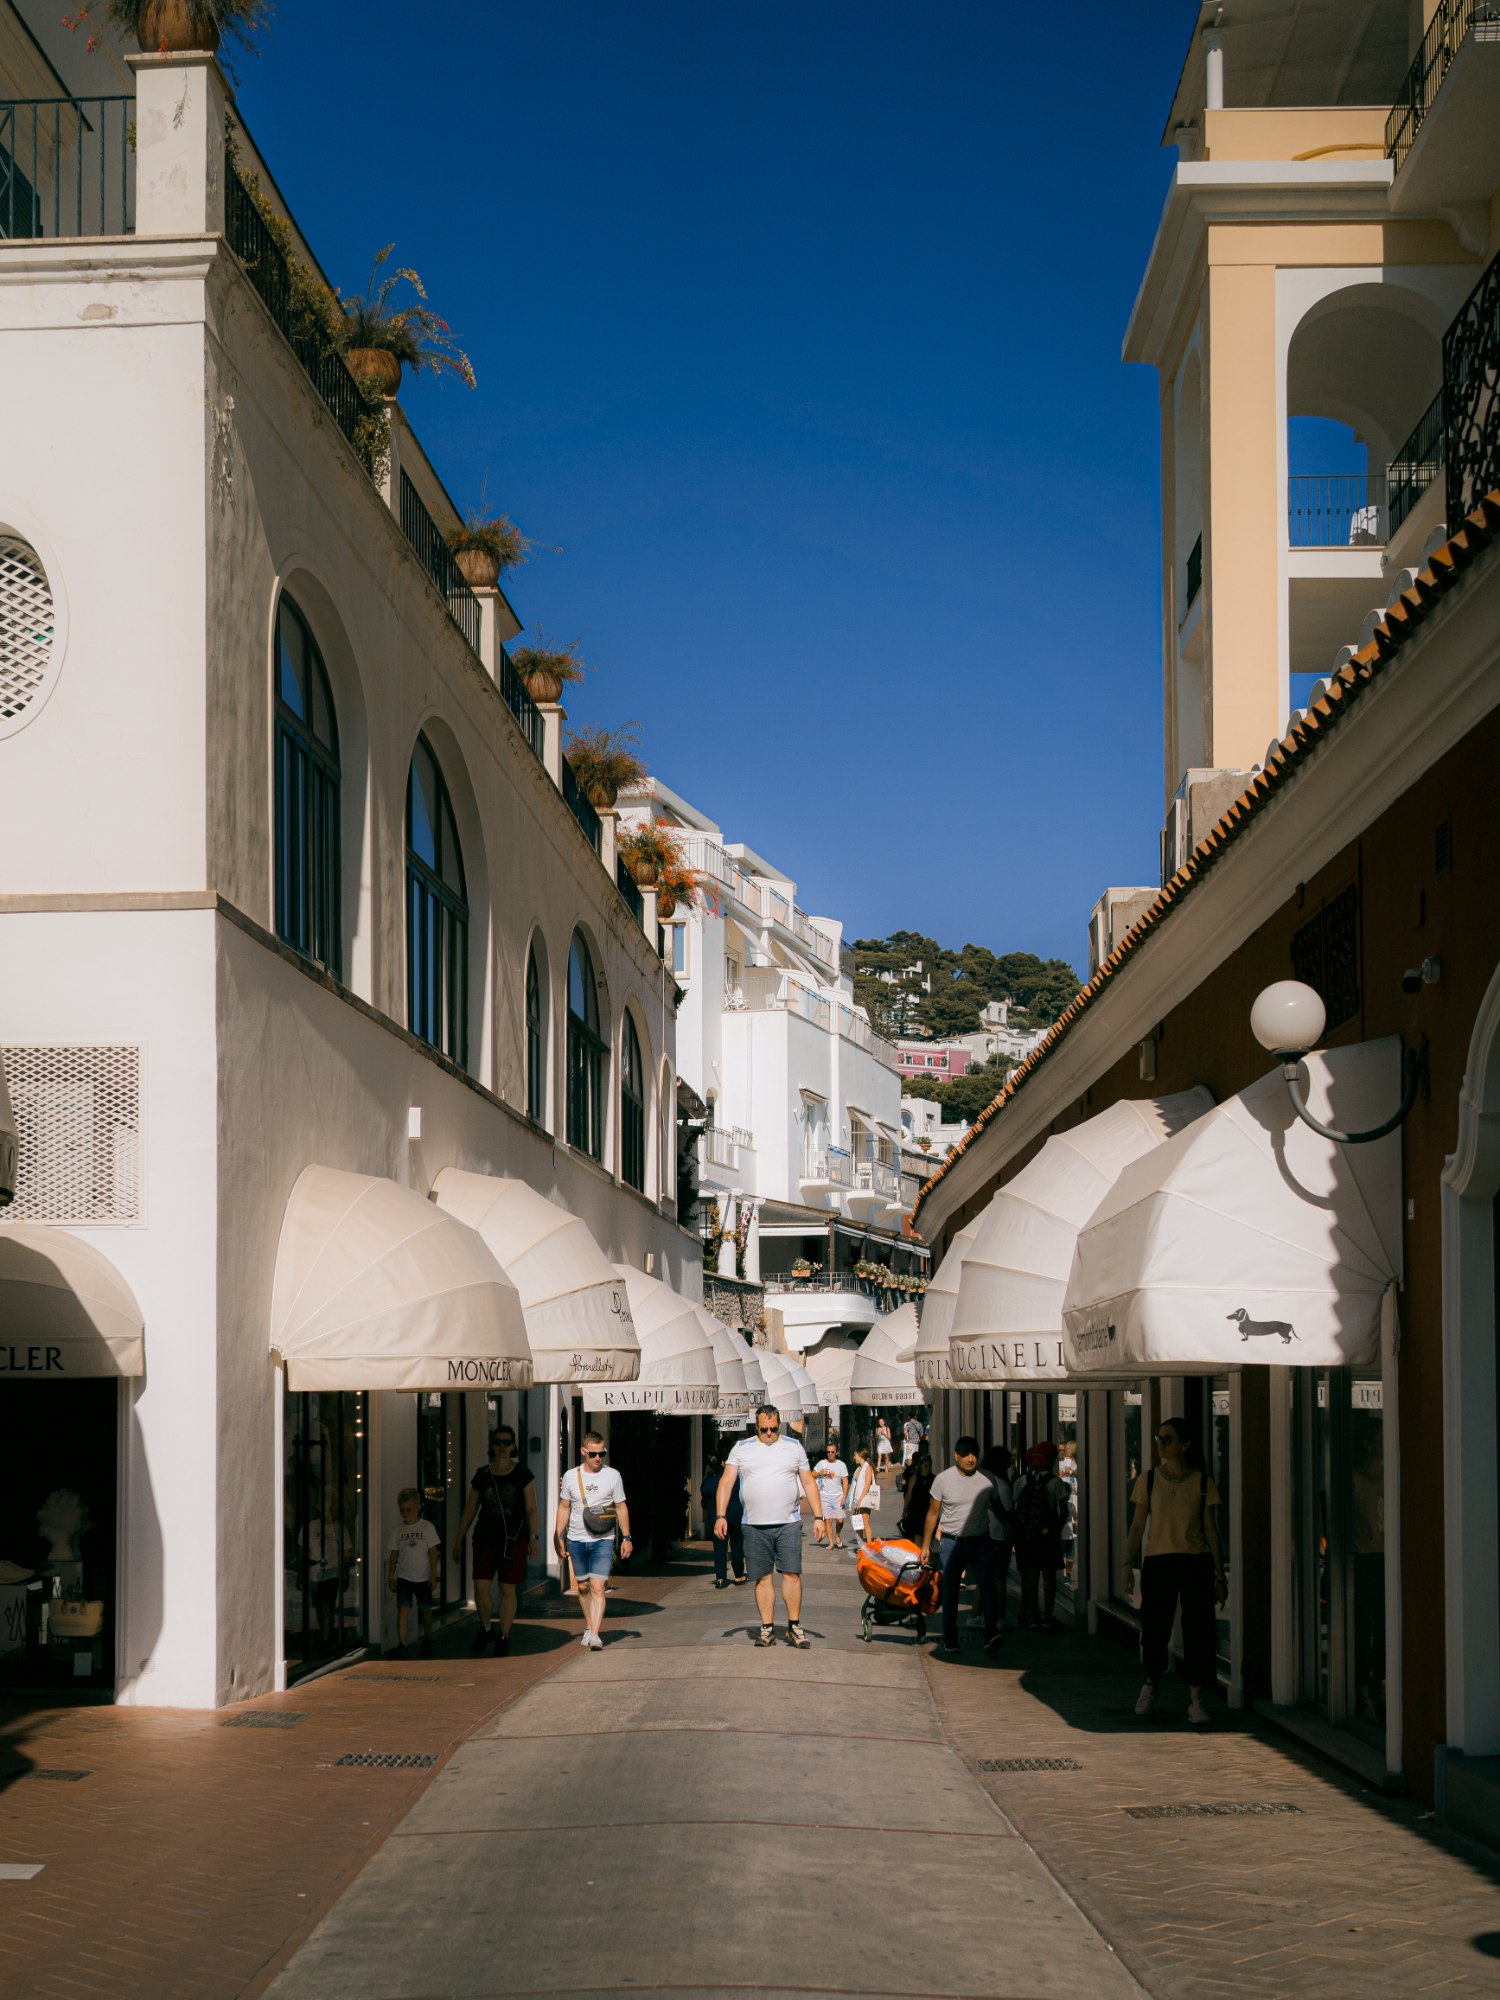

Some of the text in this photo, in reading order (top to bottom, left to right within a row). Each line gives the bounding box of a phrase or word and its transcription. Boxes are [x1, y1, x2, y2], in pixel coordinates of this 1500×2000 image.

[604, 1390, 664, 1405] RALPH
[871, 1392, 917, 1401] GOLDEN GOOSE
